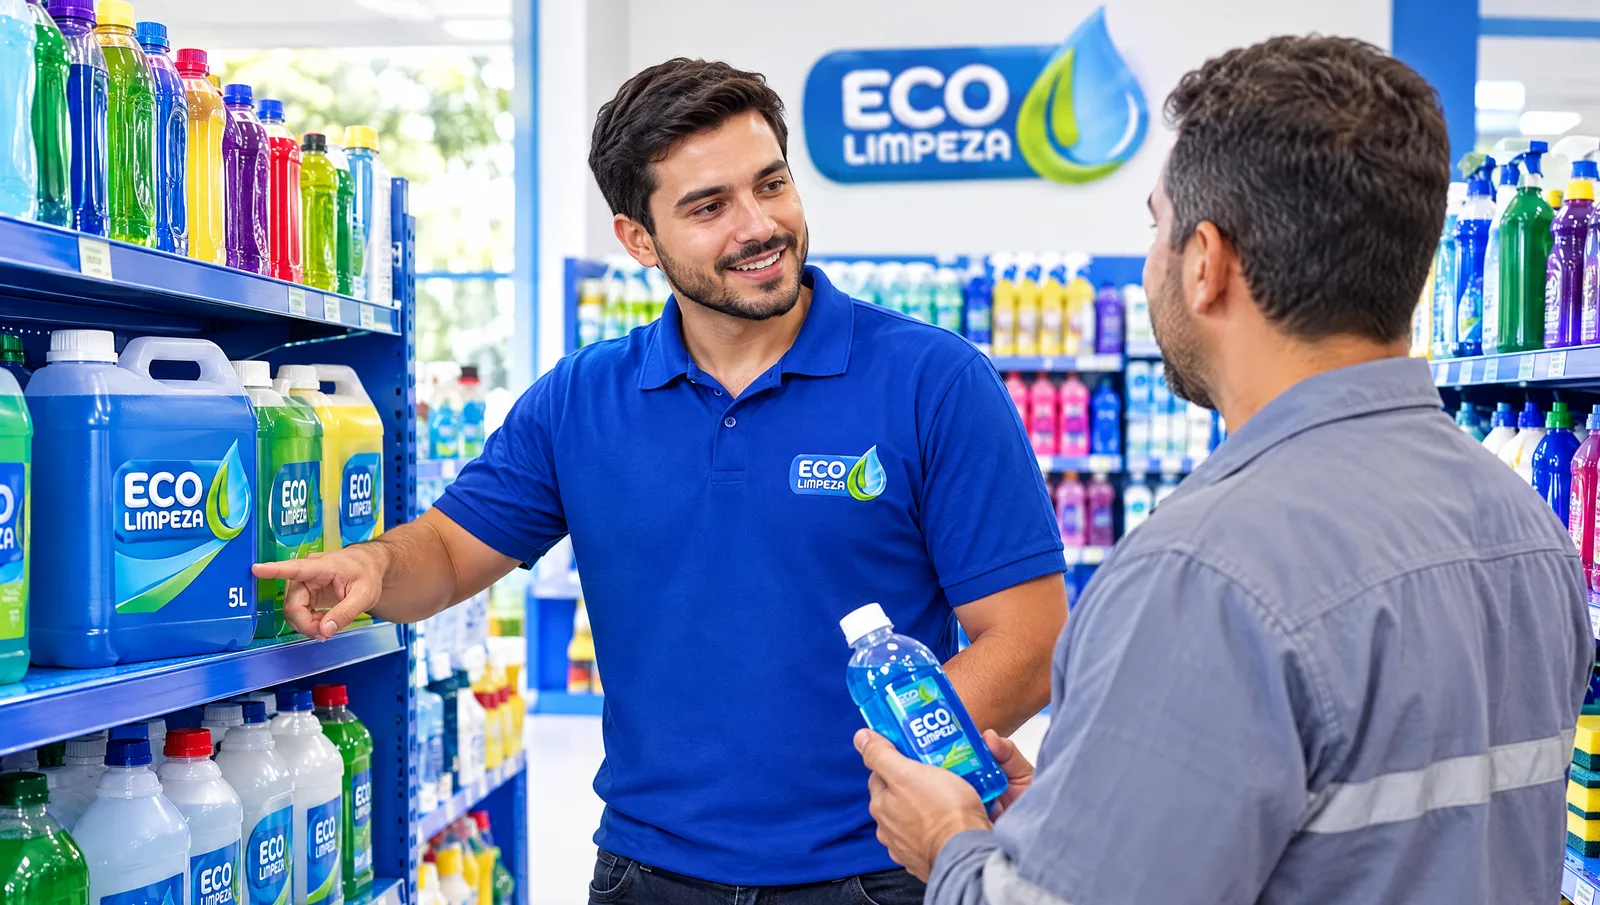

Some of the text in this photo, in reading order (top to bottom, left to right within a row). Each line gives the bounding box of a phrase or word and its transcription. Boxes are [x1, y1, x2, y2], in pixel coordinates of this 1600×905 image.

[842, 63, 1010, 130] ECO
[843, 129, 1012, 165] LIMPEZA
[798, 460, 846, 479] ECO
[124, 471, 203, 508] ECO
[281, 479, 307, 508] ECO
[350, 472, 371, 500] ECO
[797, 479, 845, 490] LIMPEZA
[124, 509, 203, 531] LIMPEZA
[281, 507, 307, 526] LIMPEZA
[349, 500, 372, 518] LIMPEZA
[228, 587, 248, 607] 5L
[909, 708, 950, 738] ECO
[916, 723, 958, 748] LIMPEZA
[355, 782, 371, 807] ECO
[315, 816, 335, 845] ECO
[259, 834, 284, 865] ECO
[200, 861, 232, 895] ECO
[259, 858, 285, 881] LIMPEZA
